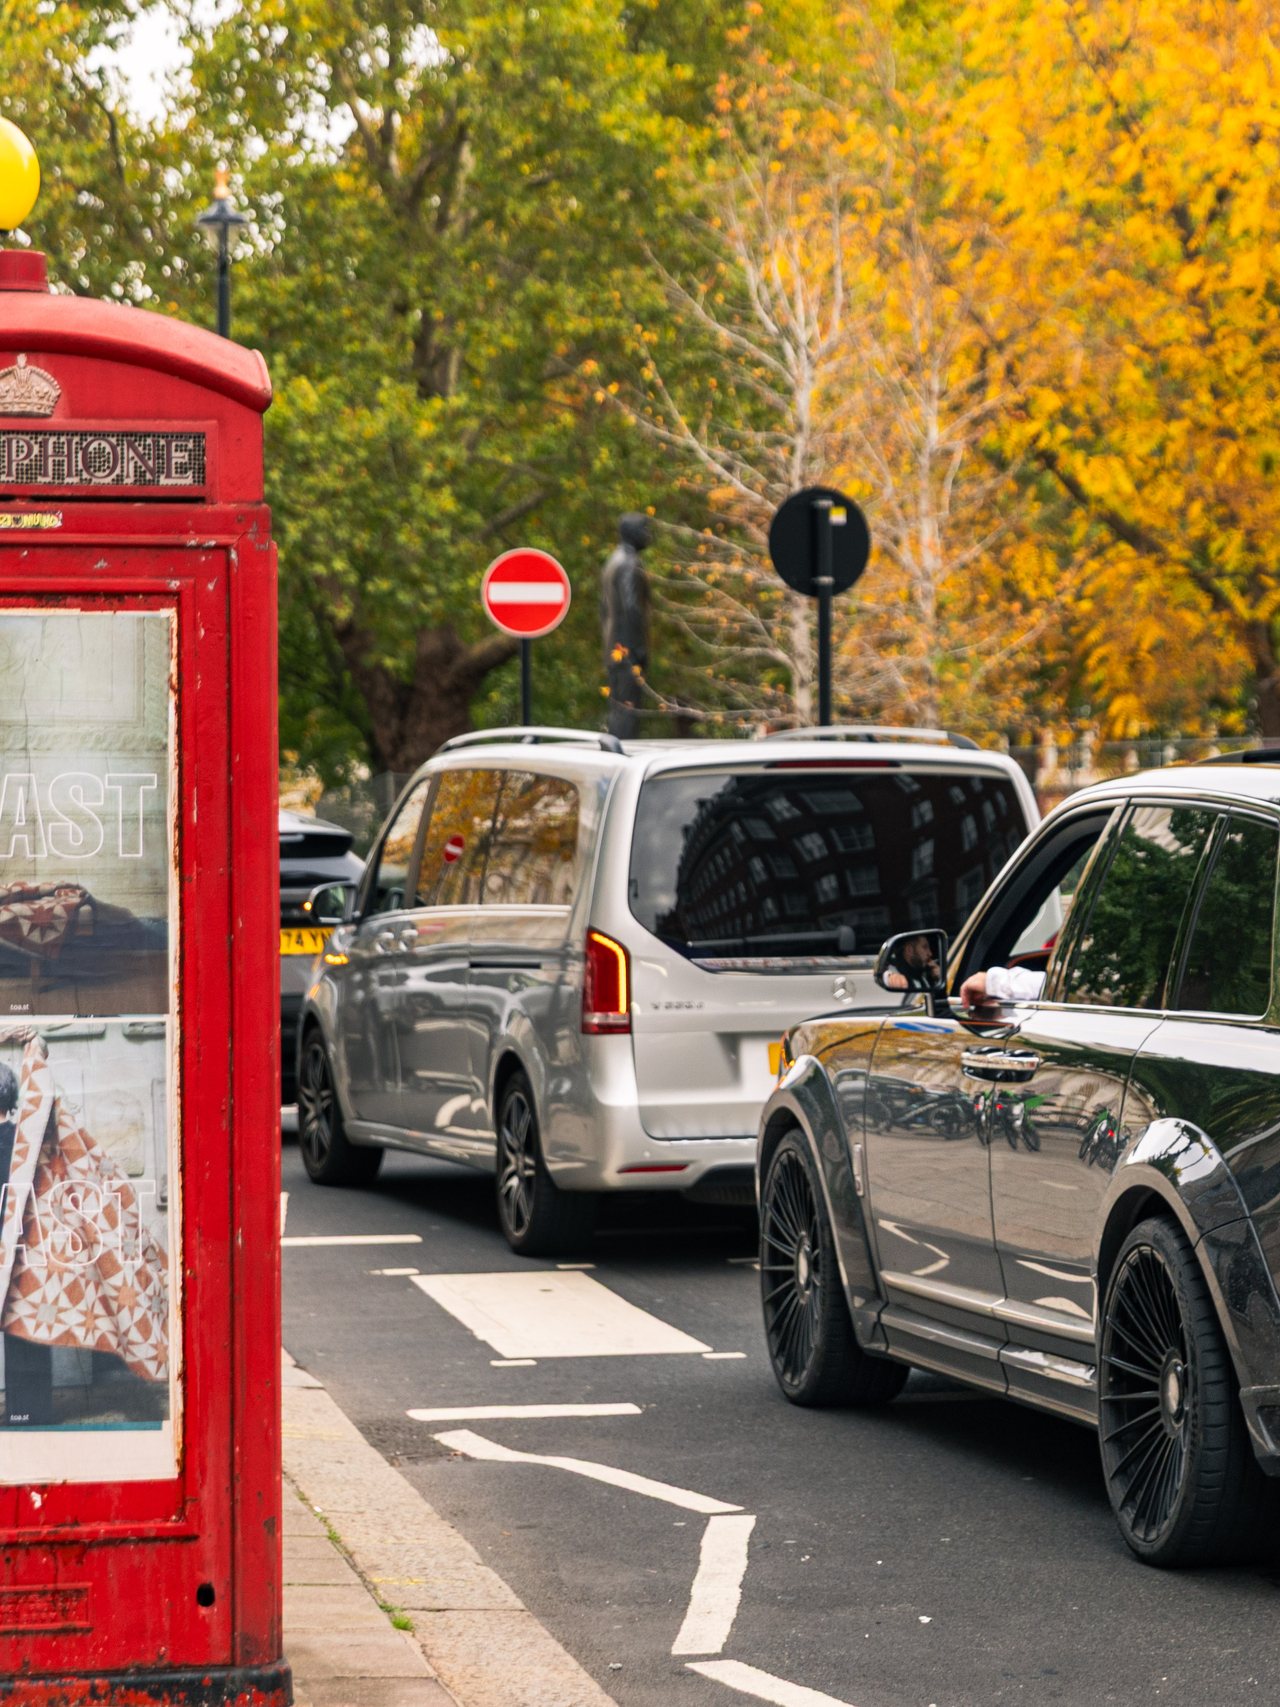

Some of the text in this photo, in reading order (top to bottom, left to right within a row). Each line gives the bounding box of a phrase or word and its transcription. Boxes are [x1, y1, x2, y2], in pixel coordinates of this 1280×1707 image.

[6, 436, 193, 479] PHONE
[0, 772, 157, 858] AST
[0, 1180, 157, 1267] AST
